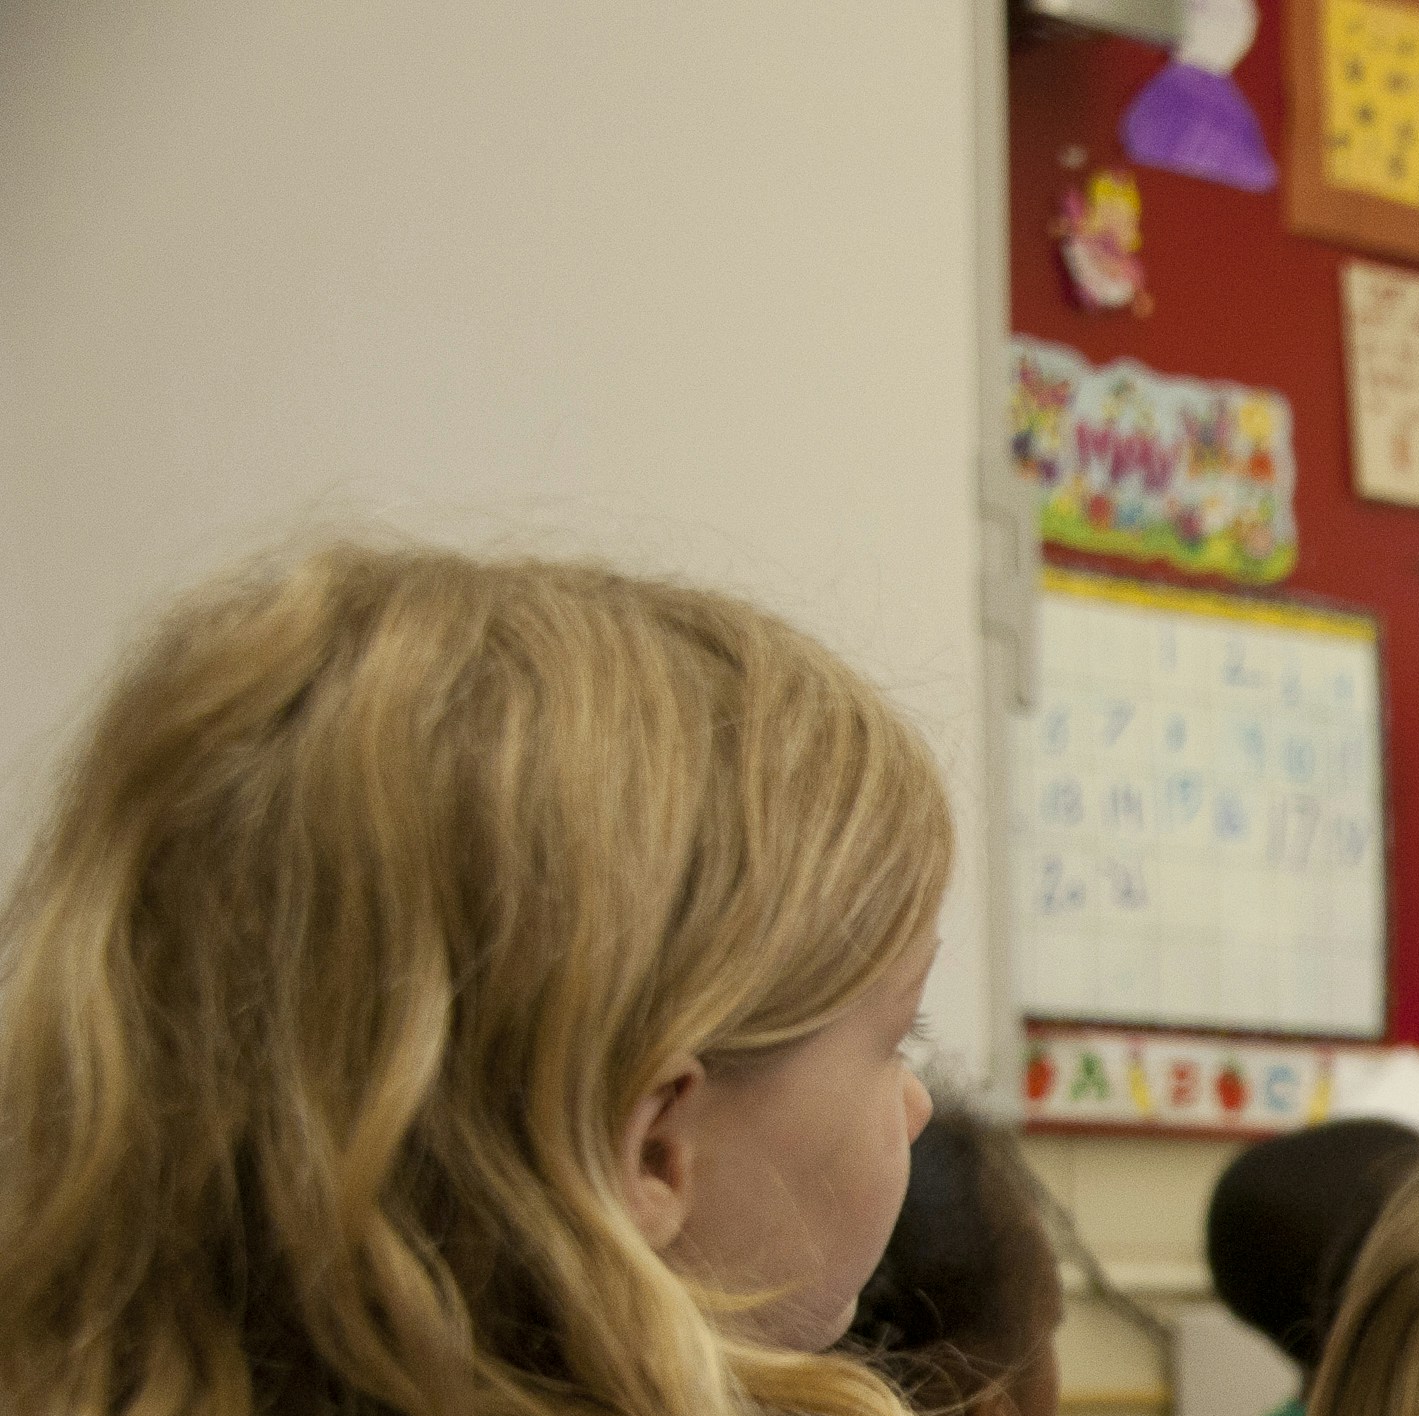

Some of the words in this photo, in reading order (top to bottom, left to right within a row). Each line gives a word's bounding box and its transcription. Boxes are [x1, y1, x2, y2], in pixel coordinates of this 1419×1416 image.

[1070, 1052, 1110, 1101] A
[1168, 1060, 1200, 1107] B
[1262, 1065, 1295, 1111] C
